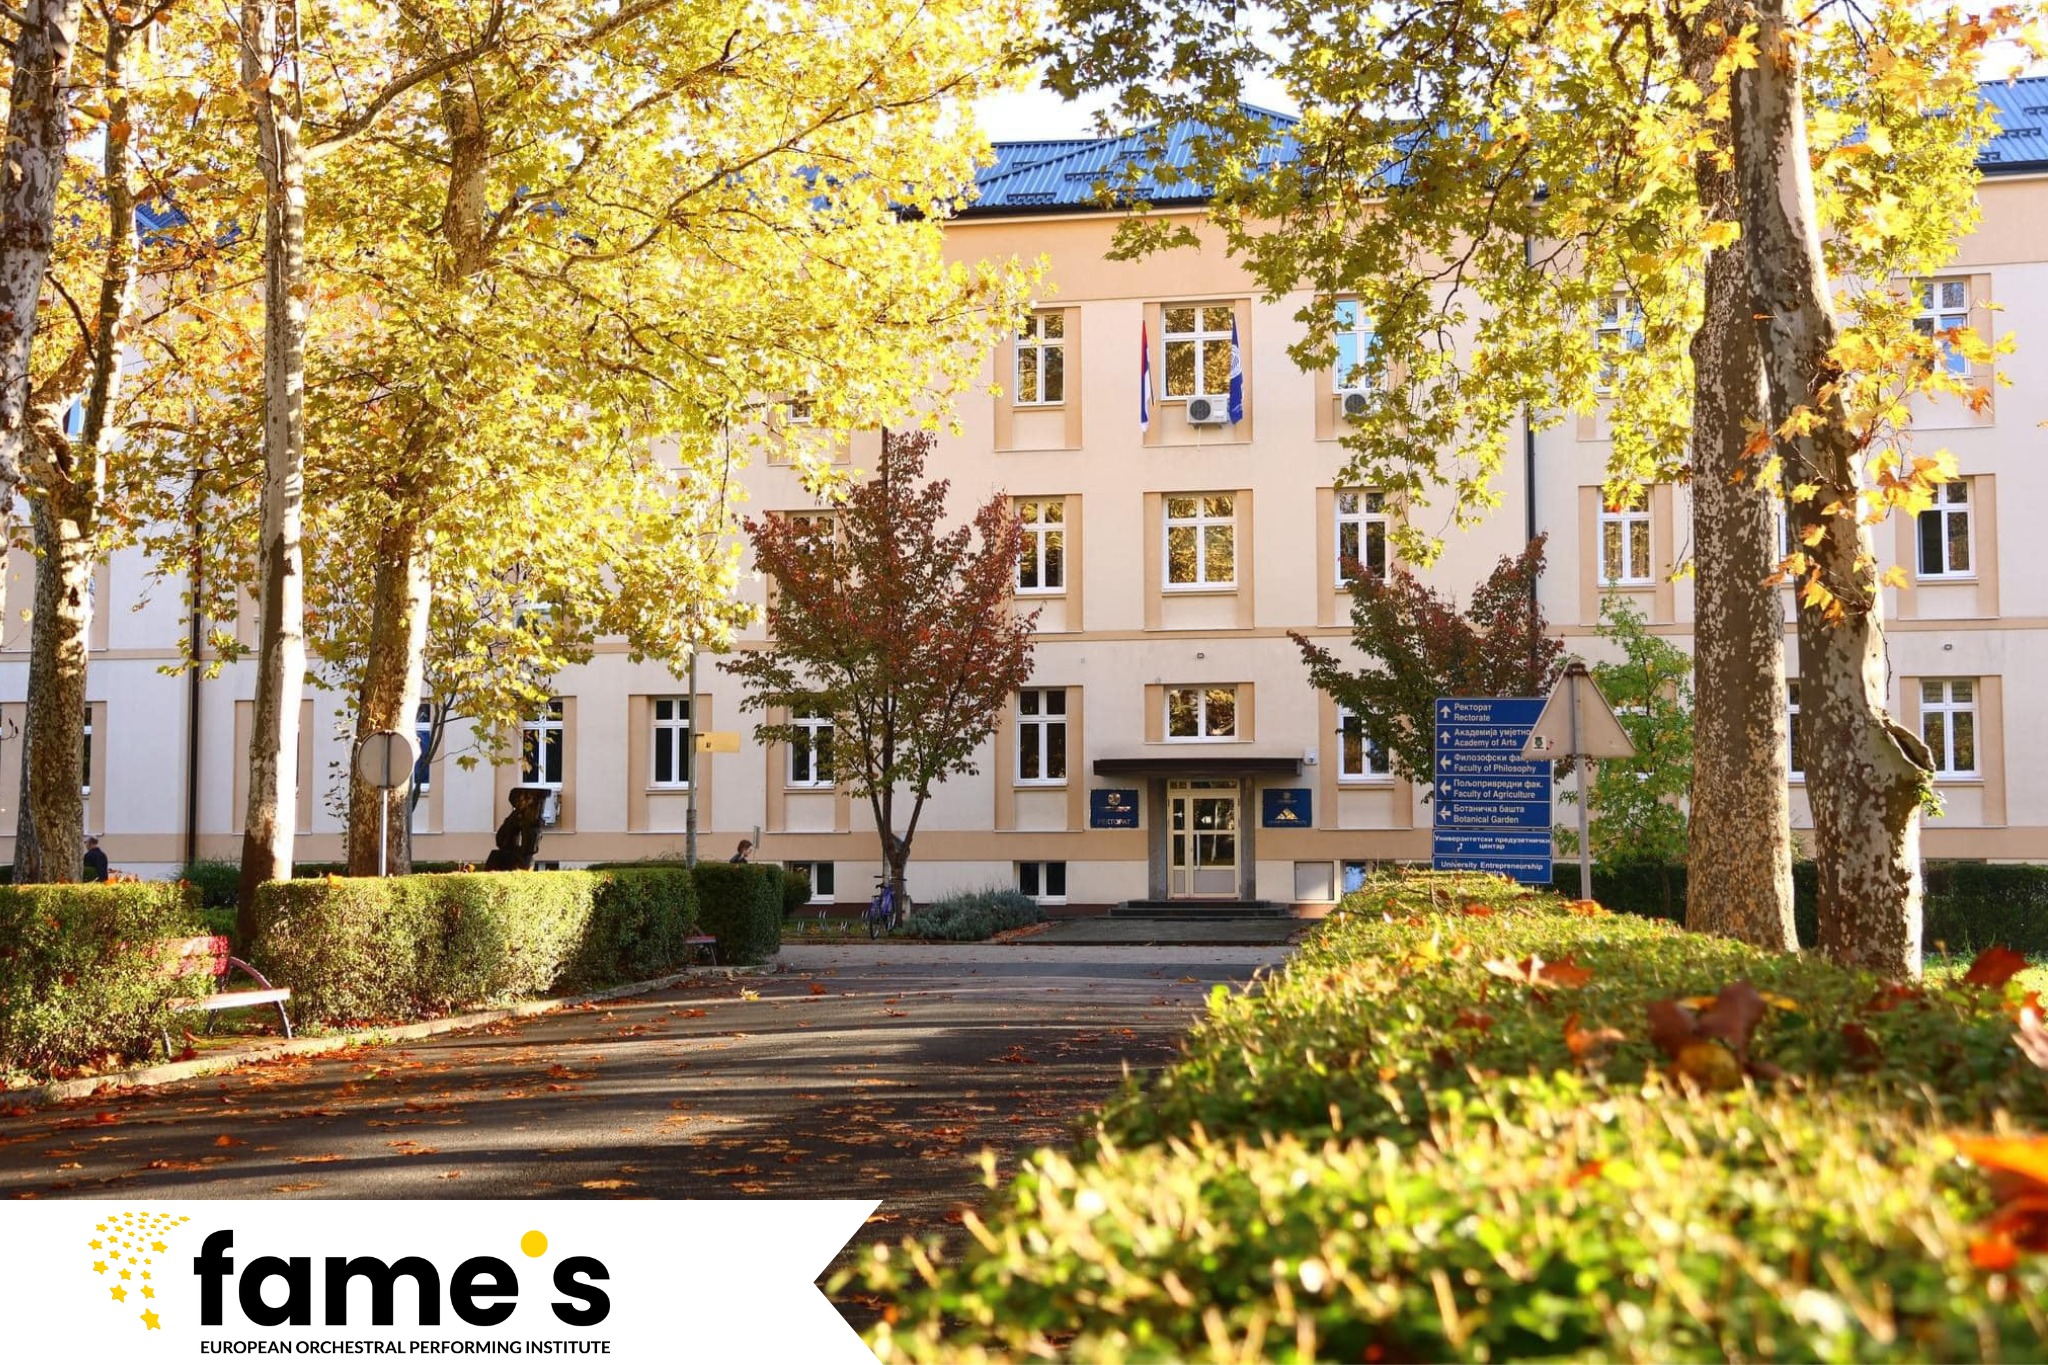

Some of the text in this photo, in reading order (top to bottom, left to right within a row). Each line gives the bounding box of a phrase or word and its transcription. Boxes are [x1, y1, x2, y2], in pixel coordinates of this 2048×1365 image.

[1454, 703, 1492, 712] Ректорат
[1454, 713, 1491, 722] Rectorate
[1454, 728, 1531, 738] Академија умјетно
[1454, 738, 1517, 748] Academy of Arts
[1454, 753, 1507, 763] Филозофски
[1454, 764, 1536, 774] Faculty of Philosophy
[1453, 779, 1543, 789] Пољопривредни фак.
[1453, 790, 1535, 800] Faculty of Agriculture
[1453, 804, 1525, 813] Ботаничка башта
[1453, 814, 1519, 823] Botanical Garden
[1441, 861, 1544, 871] University Entrepreneurship
